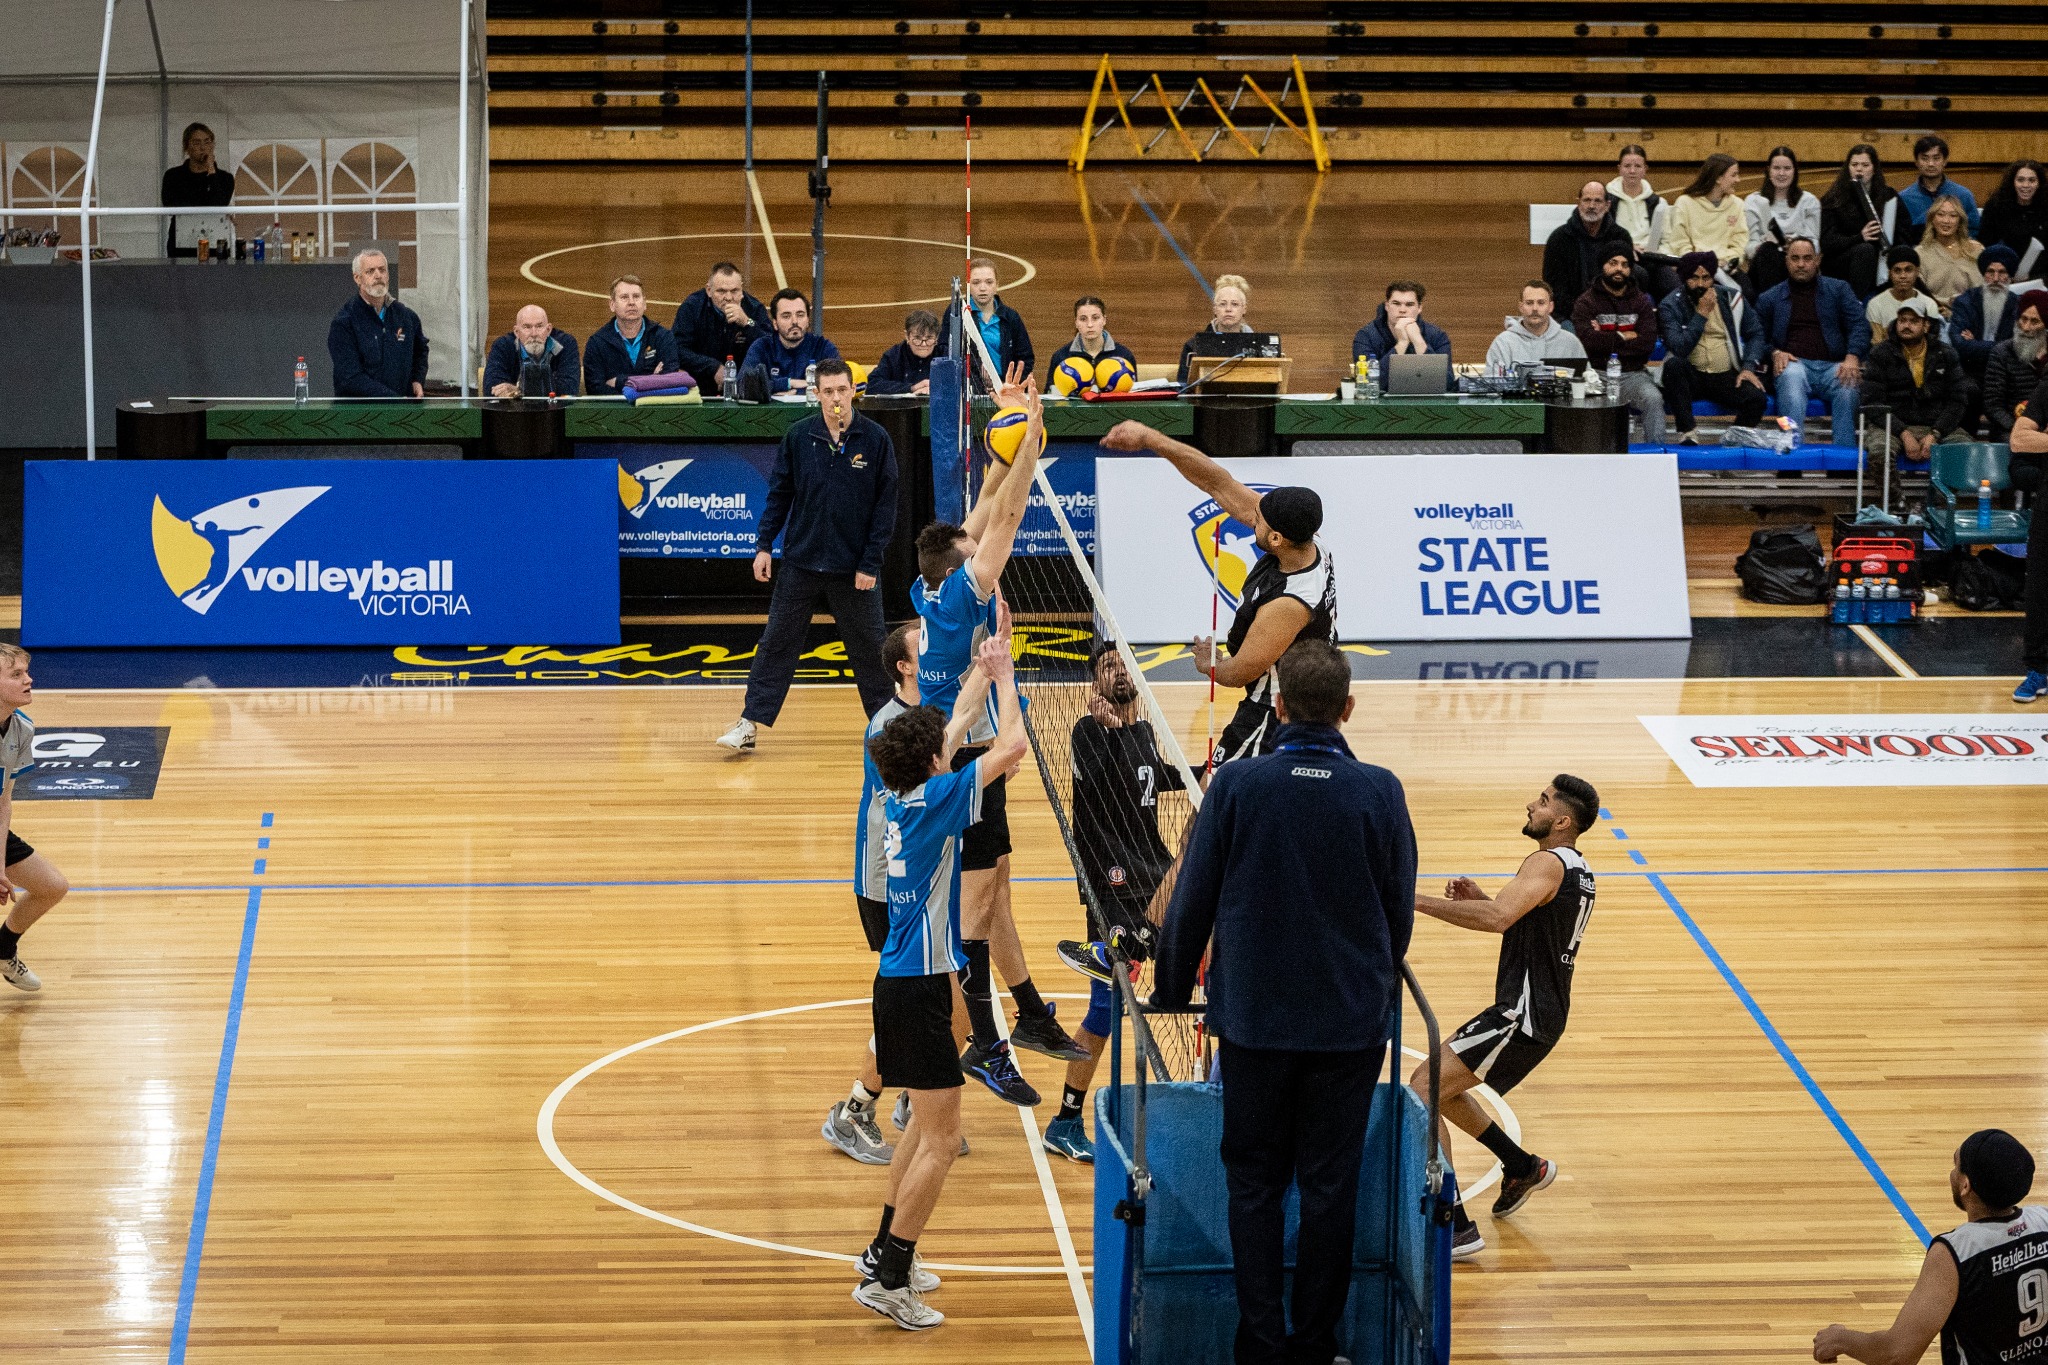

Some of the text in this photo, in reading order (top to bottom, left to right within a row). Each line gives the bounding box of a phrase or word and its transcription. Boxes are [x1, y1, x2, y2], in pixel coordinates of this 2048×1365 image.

[655, 492, 746, 513] volleyball
[1413, 503, 1514, 522] volleyball
[705, 509, 753, 521] VICTORIA
[1470, 519, 1524, 531] VICTORIA
[1418, 537, 1550, 573] STATE
[241, 560, 453, 600] volleyball
[358, 594, 472, 616] VICTORIA
[1420, 580, 1600, 616] LEAGUE
[1938, 725, 1957, 735] of
[1690, 734, 2036, 759] SELWOOD
[1137, 765, 1156, 807] 2
[2017, 1268, 2048, 1338] 9
